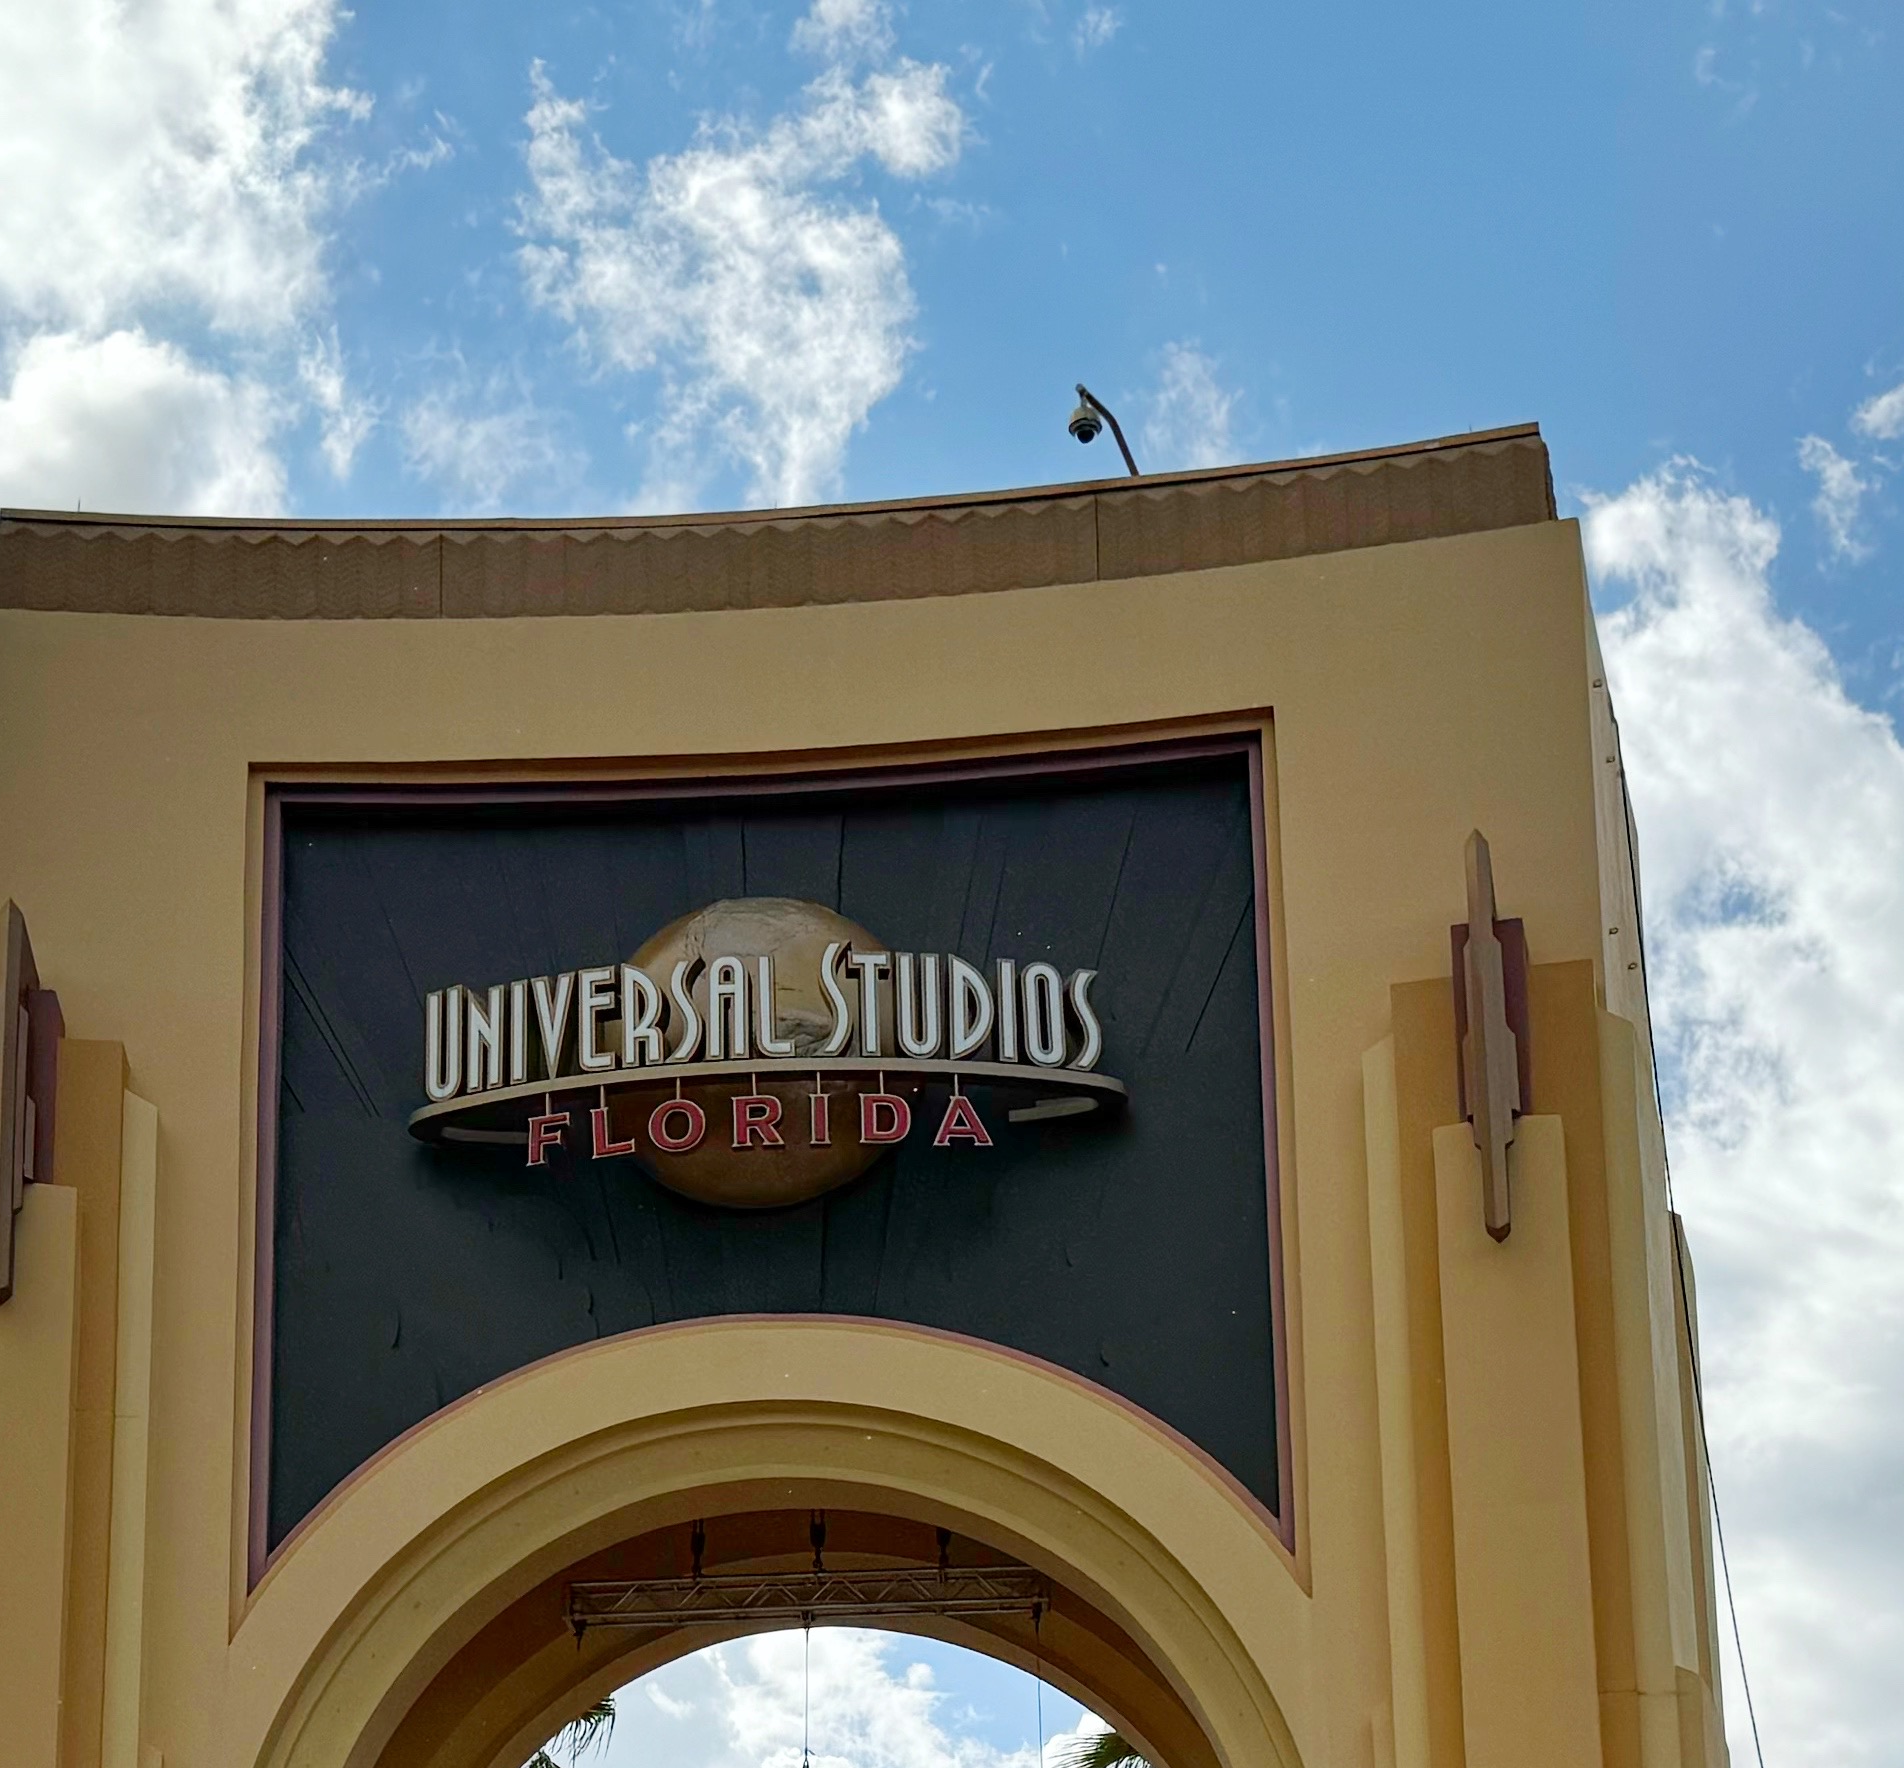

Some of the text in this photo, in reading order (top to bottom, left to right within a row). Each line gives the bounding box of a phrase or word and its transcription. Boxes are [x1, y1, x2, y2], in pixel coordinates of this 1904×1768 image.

[425, 941, 1104, 1103] UNIVERSAL STUDIOS
[526, 1092, 994, 1168] FLORIDA
